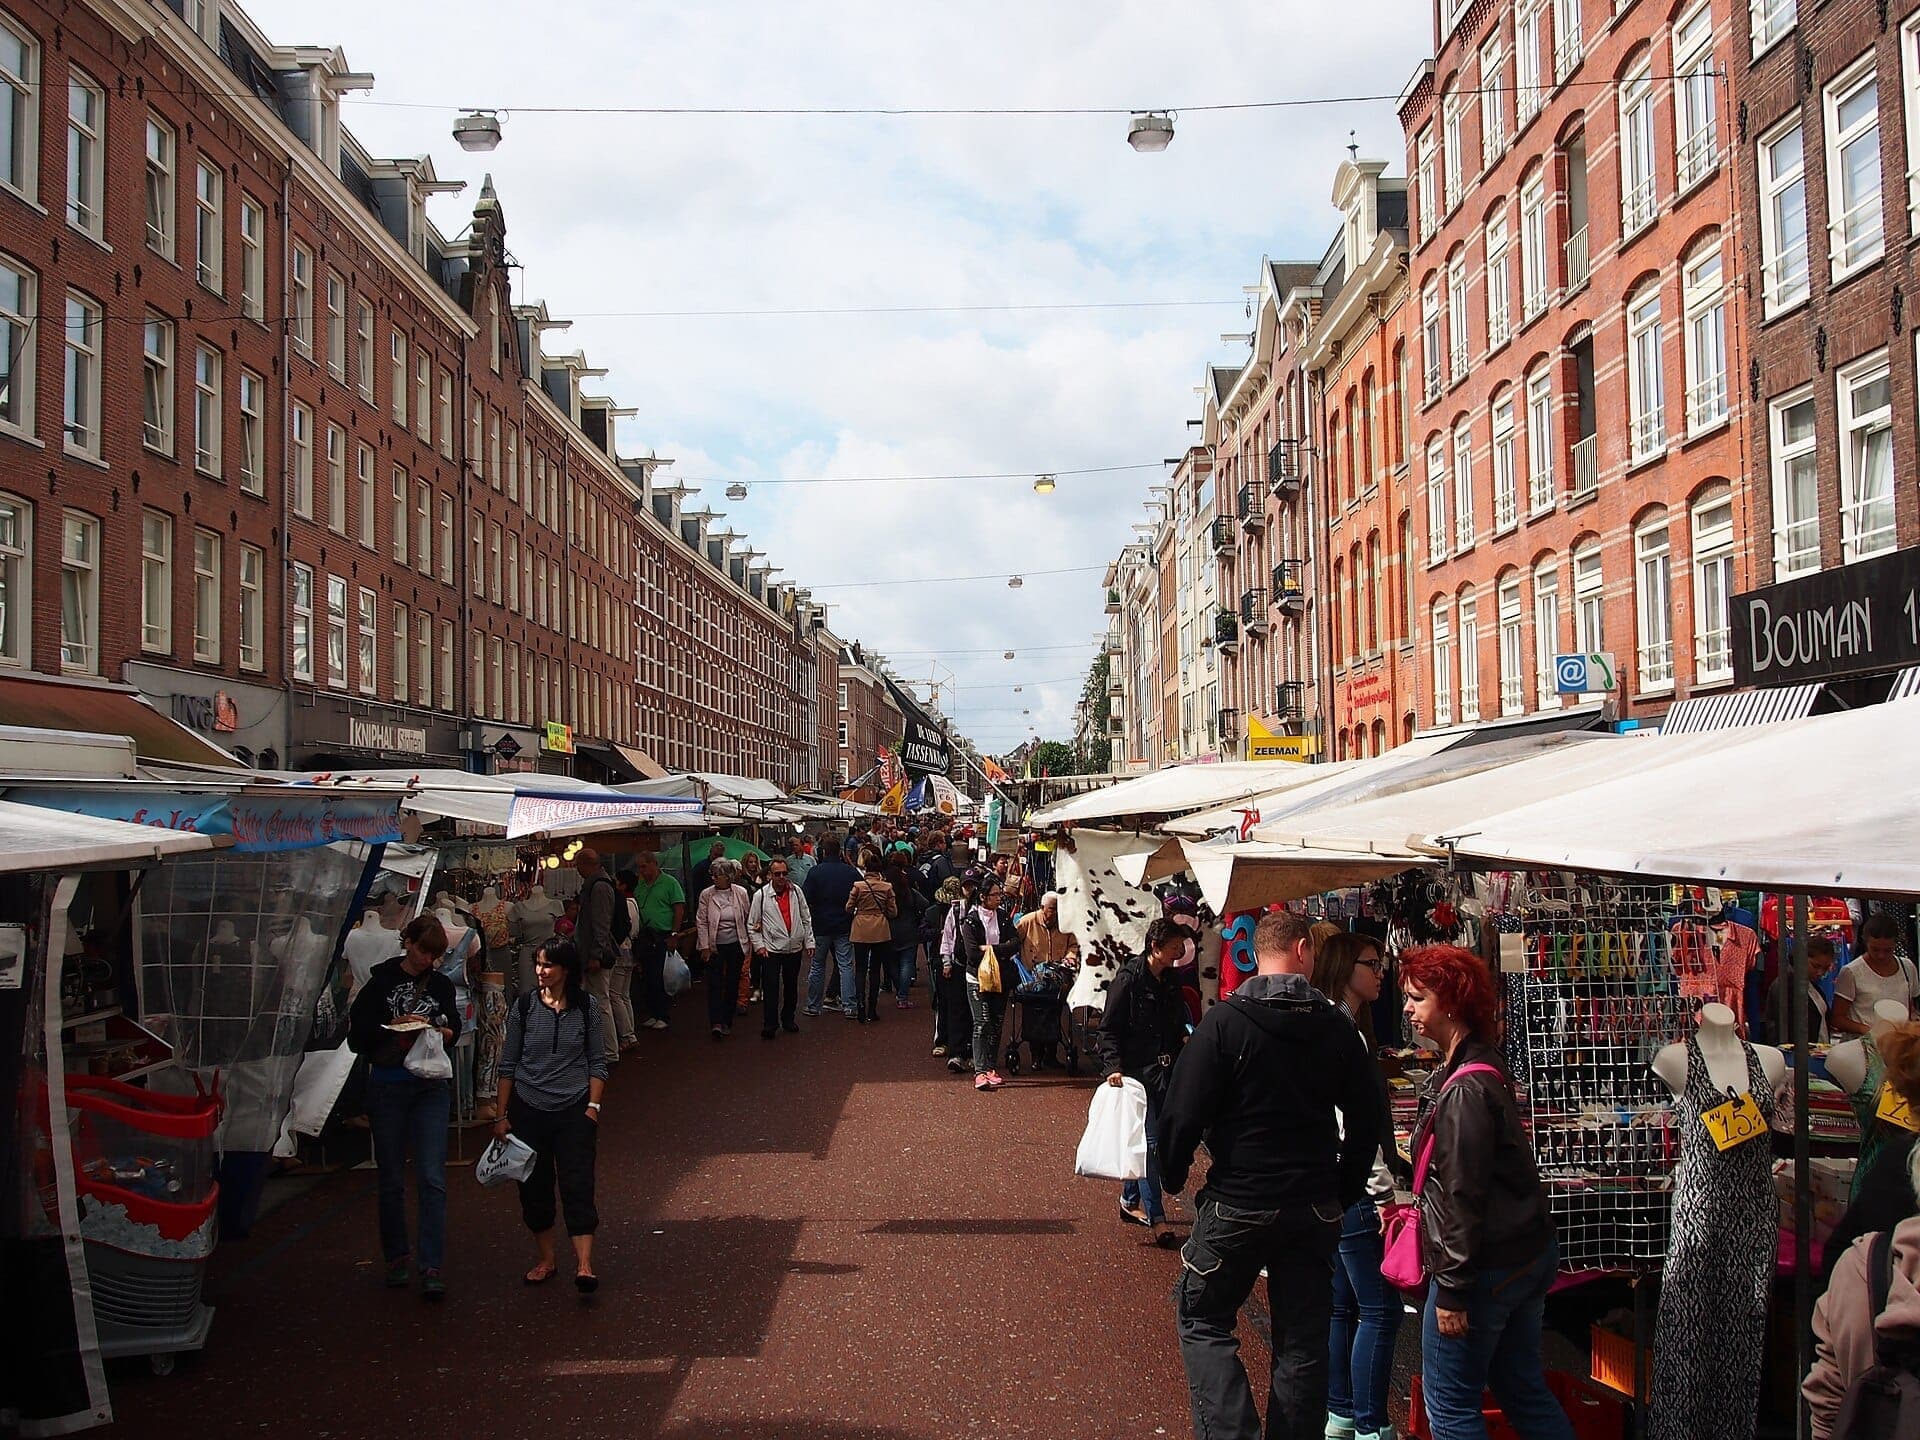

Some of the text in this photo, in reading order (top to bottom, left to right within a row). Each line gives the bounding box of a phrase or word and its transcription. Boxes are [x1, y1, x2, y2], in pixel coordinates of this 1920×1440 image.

[1749, 597, 1873, 673] BOUMAN
[355, 721, 394, 750] KNIPHAL
[1254, 746, 1300, 757] ZEEMAN
[1708, 1110, 1721, 1122] NU
